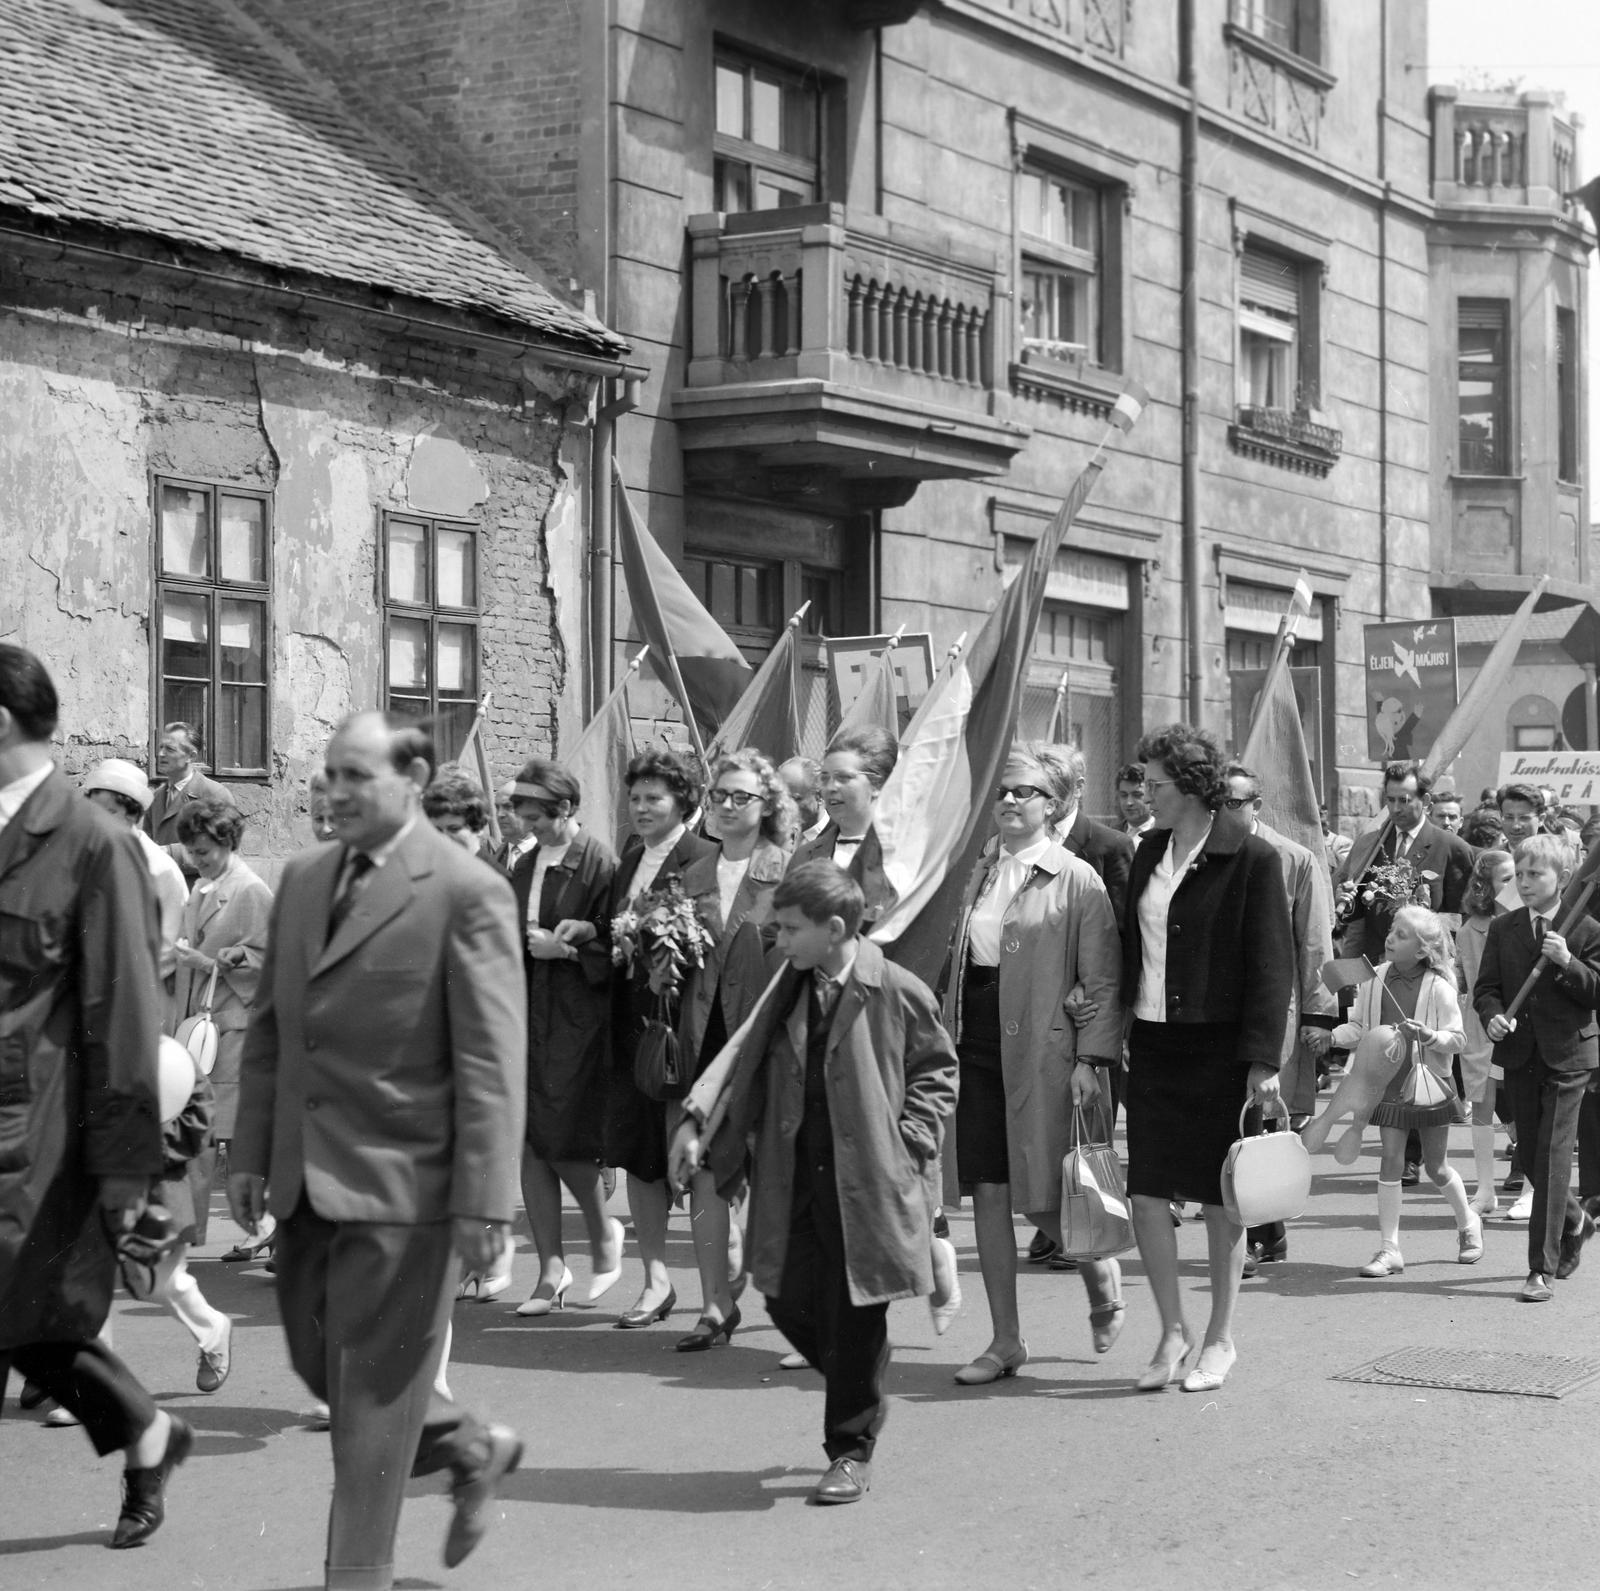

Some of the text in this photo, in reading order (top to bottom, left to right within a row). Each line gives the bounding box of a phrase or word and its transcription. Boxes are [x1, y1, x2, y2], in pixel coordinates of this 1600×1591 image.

[1370, 650, 1450, 670] ÉLJEN MÁJUS 1
